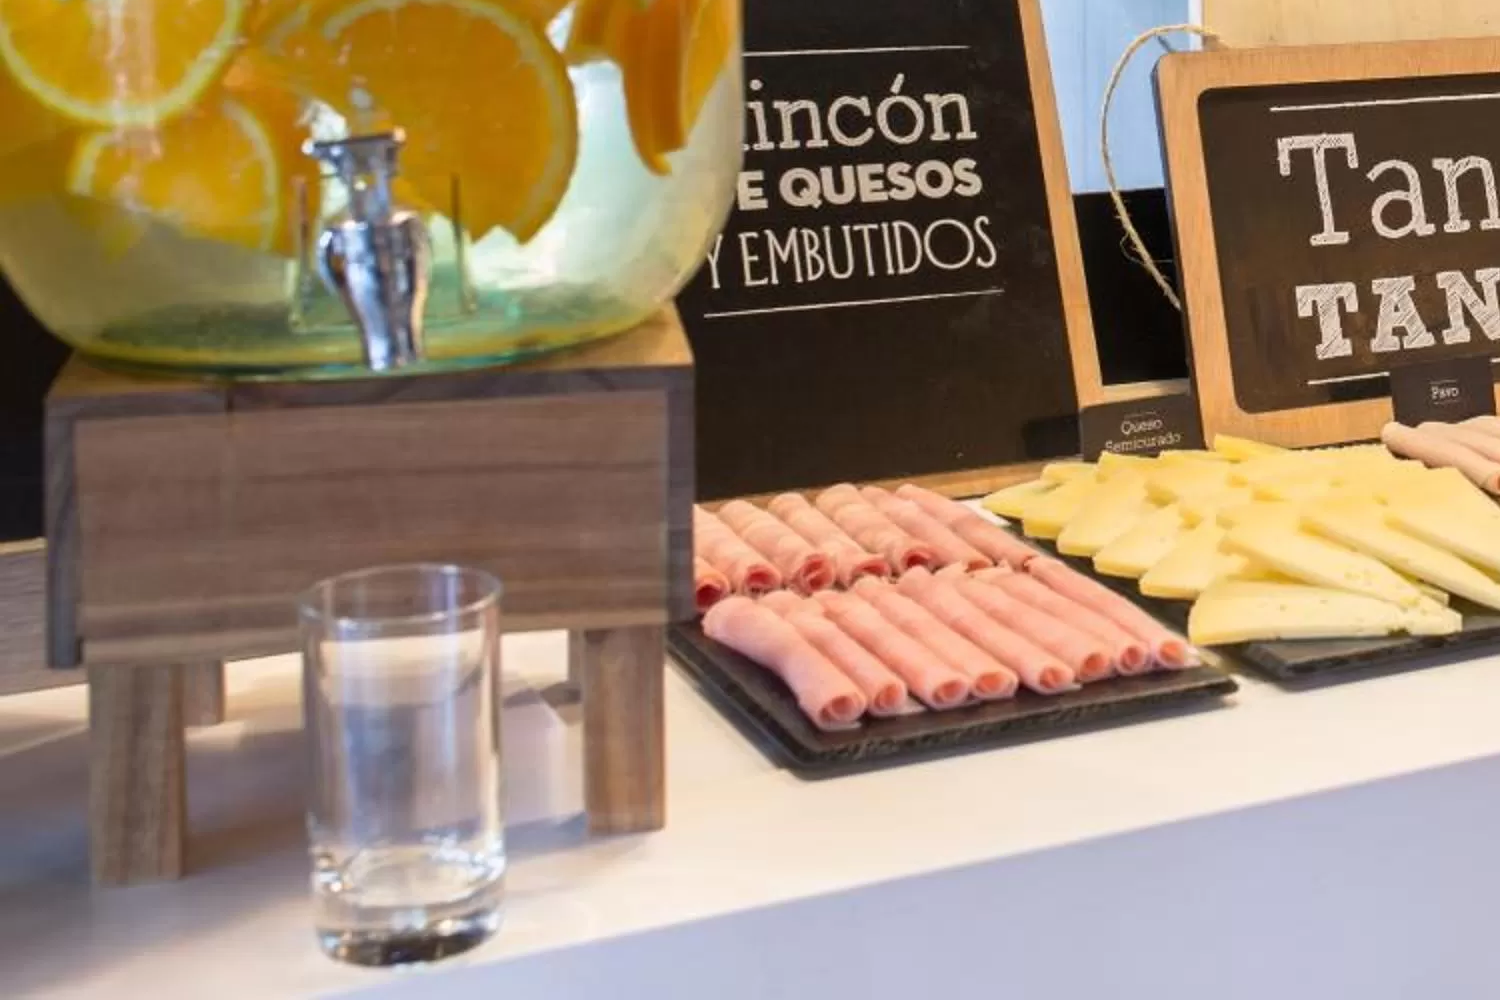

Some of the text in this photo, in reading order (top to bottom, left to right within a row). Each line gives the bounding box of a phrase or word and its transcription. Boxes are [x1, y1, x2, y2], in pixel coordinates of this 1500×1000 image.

[742, 72, 978, 151] incón
[736, 157, 983, 211] E QUESOS
[705, 215, 998, 289] Y EMBUTIDOS
[1120, 419, 1162, 436] Queso
